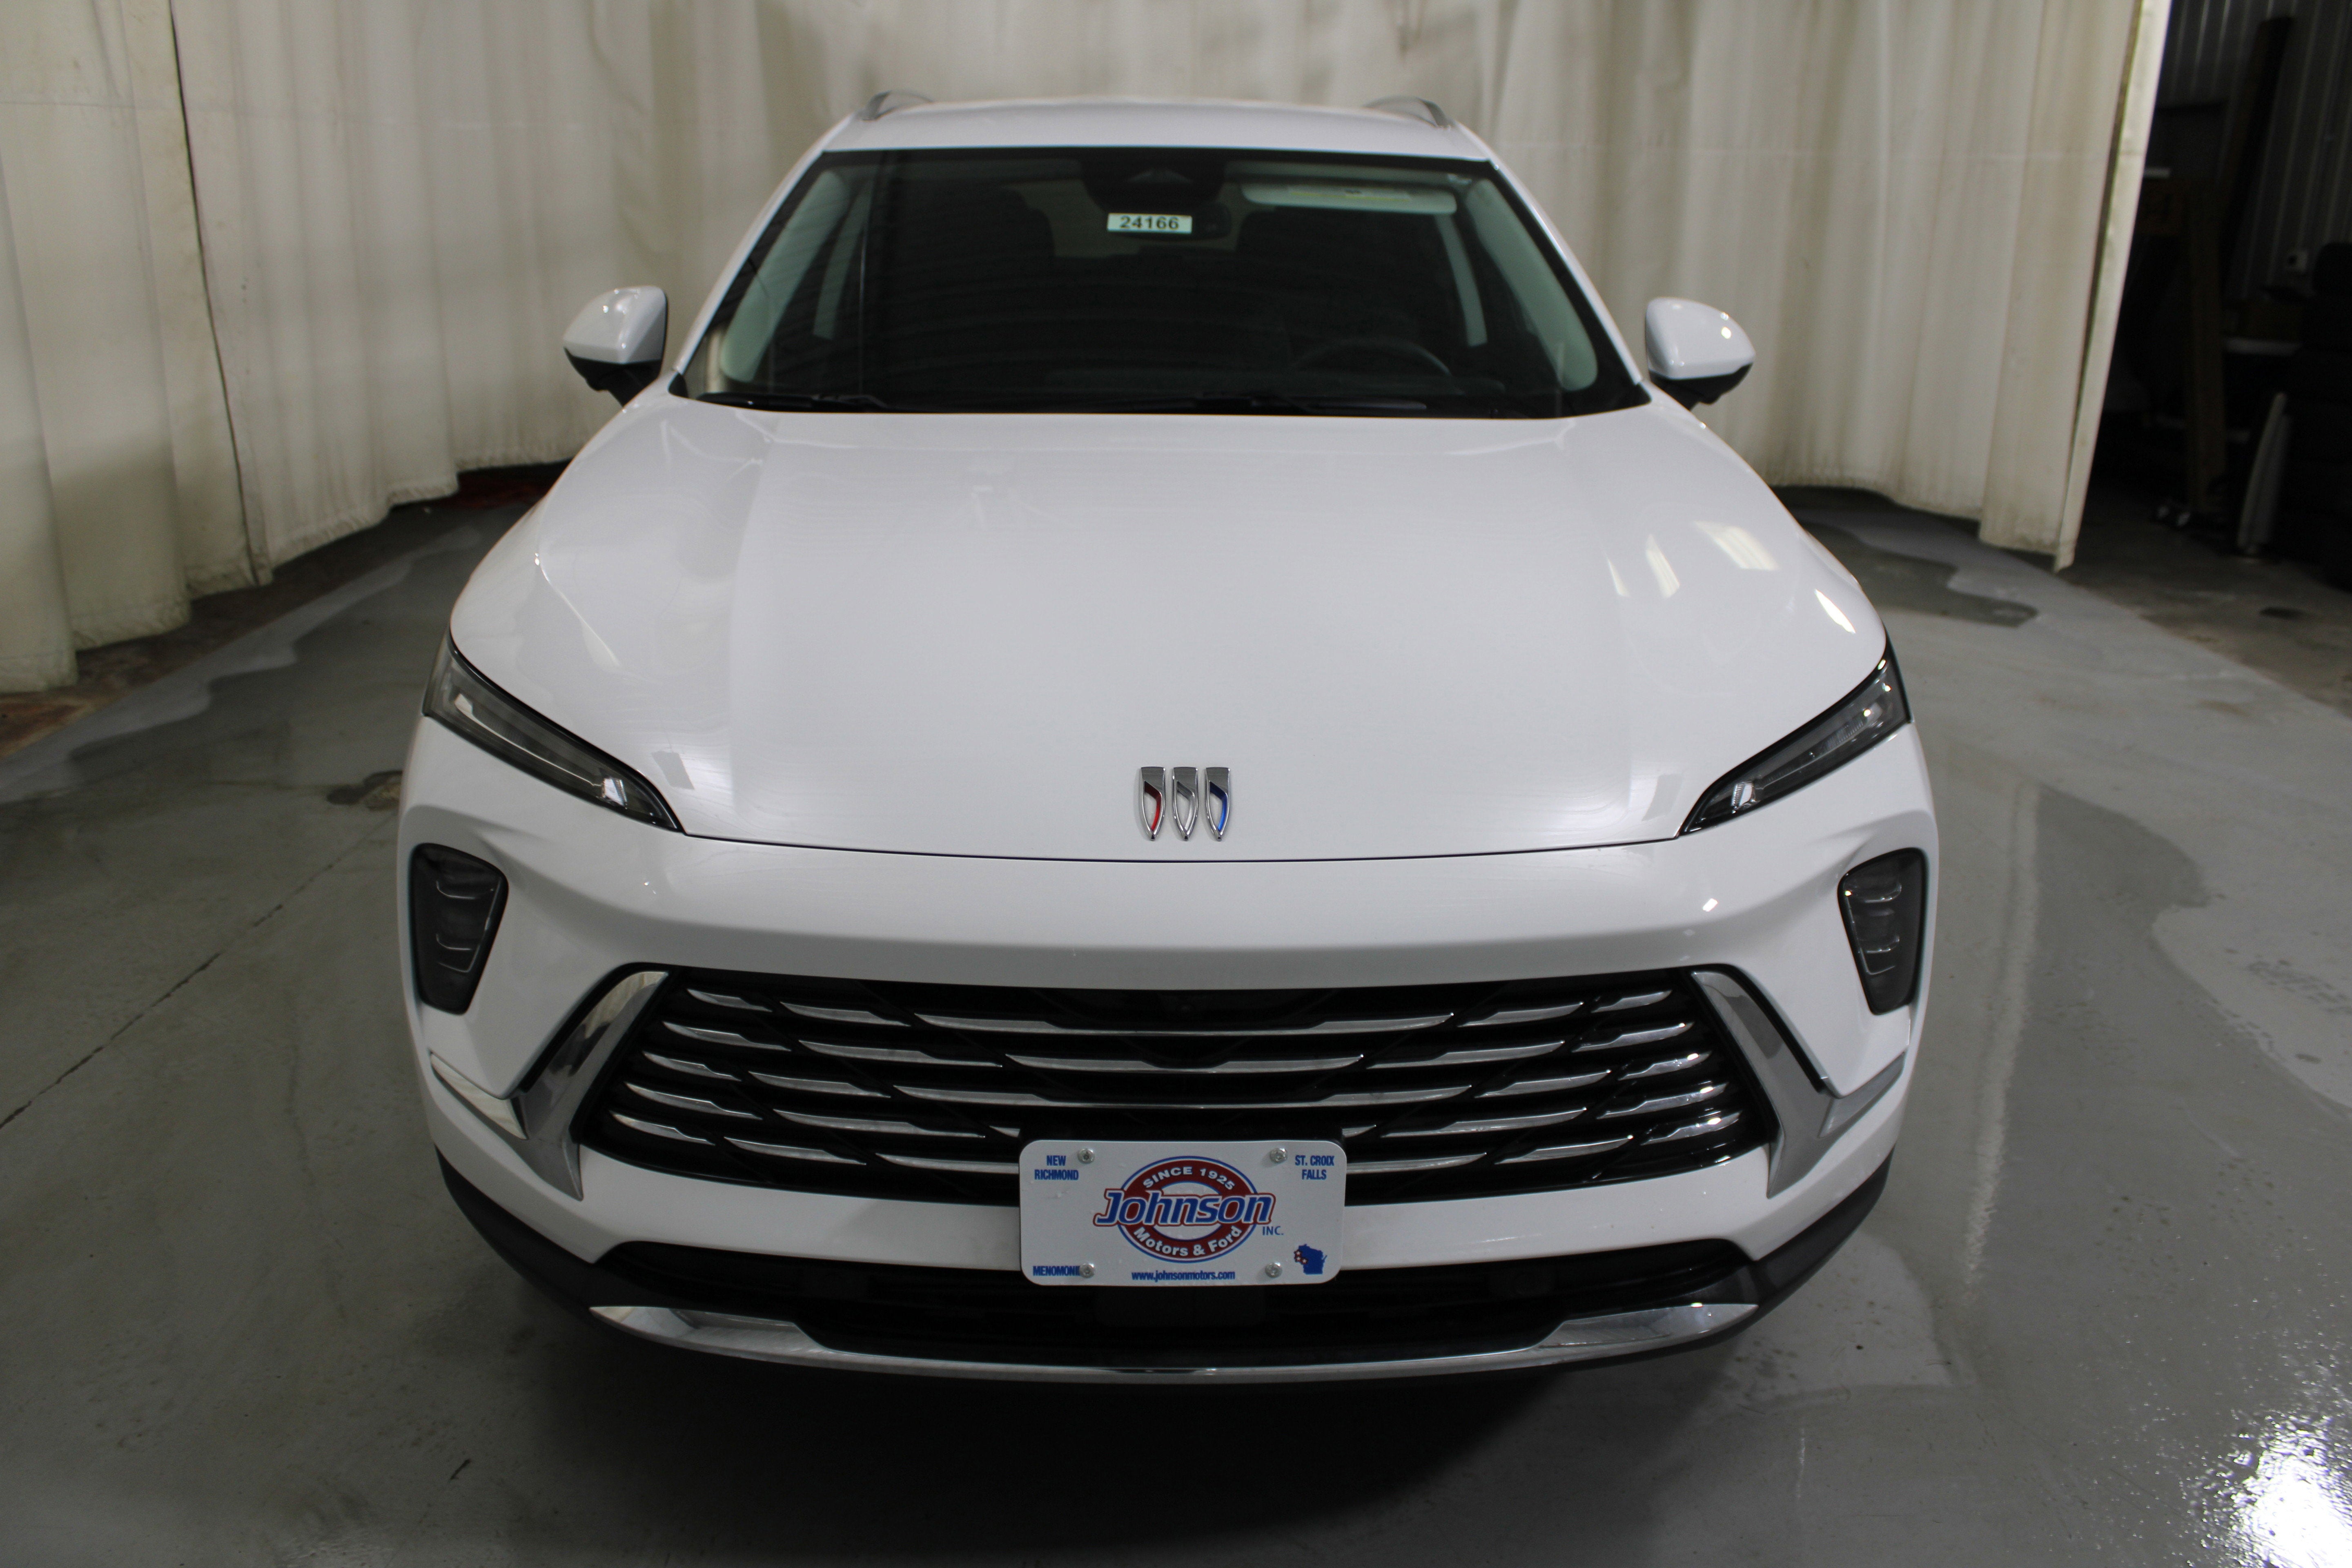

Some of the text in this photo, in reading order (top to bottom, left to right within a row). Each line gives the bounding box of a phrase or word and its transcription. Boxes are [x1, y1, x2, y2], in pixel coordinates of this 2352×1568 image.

[1120, 216, 1179, 230] 24166
[1047, 1155, 1066, 1166] NEW
[1295, 1155, 1335, 1166] ST. CROIX
[1034, 1169, 1079, 1180] RICHMOND
[1143, 1166, 1235, 1190] SINCE 1925
[1302, 1169, 1327, 1180] FALLS
[1094, 1189, 1276, 1226] Johnson
[1262, 1226, 1284, 1236] INC.
[1134, 1225, 1242, 1256] Motors & Ford
[1131, 1270, 1235, 1283] www.johnsonmotors.com
